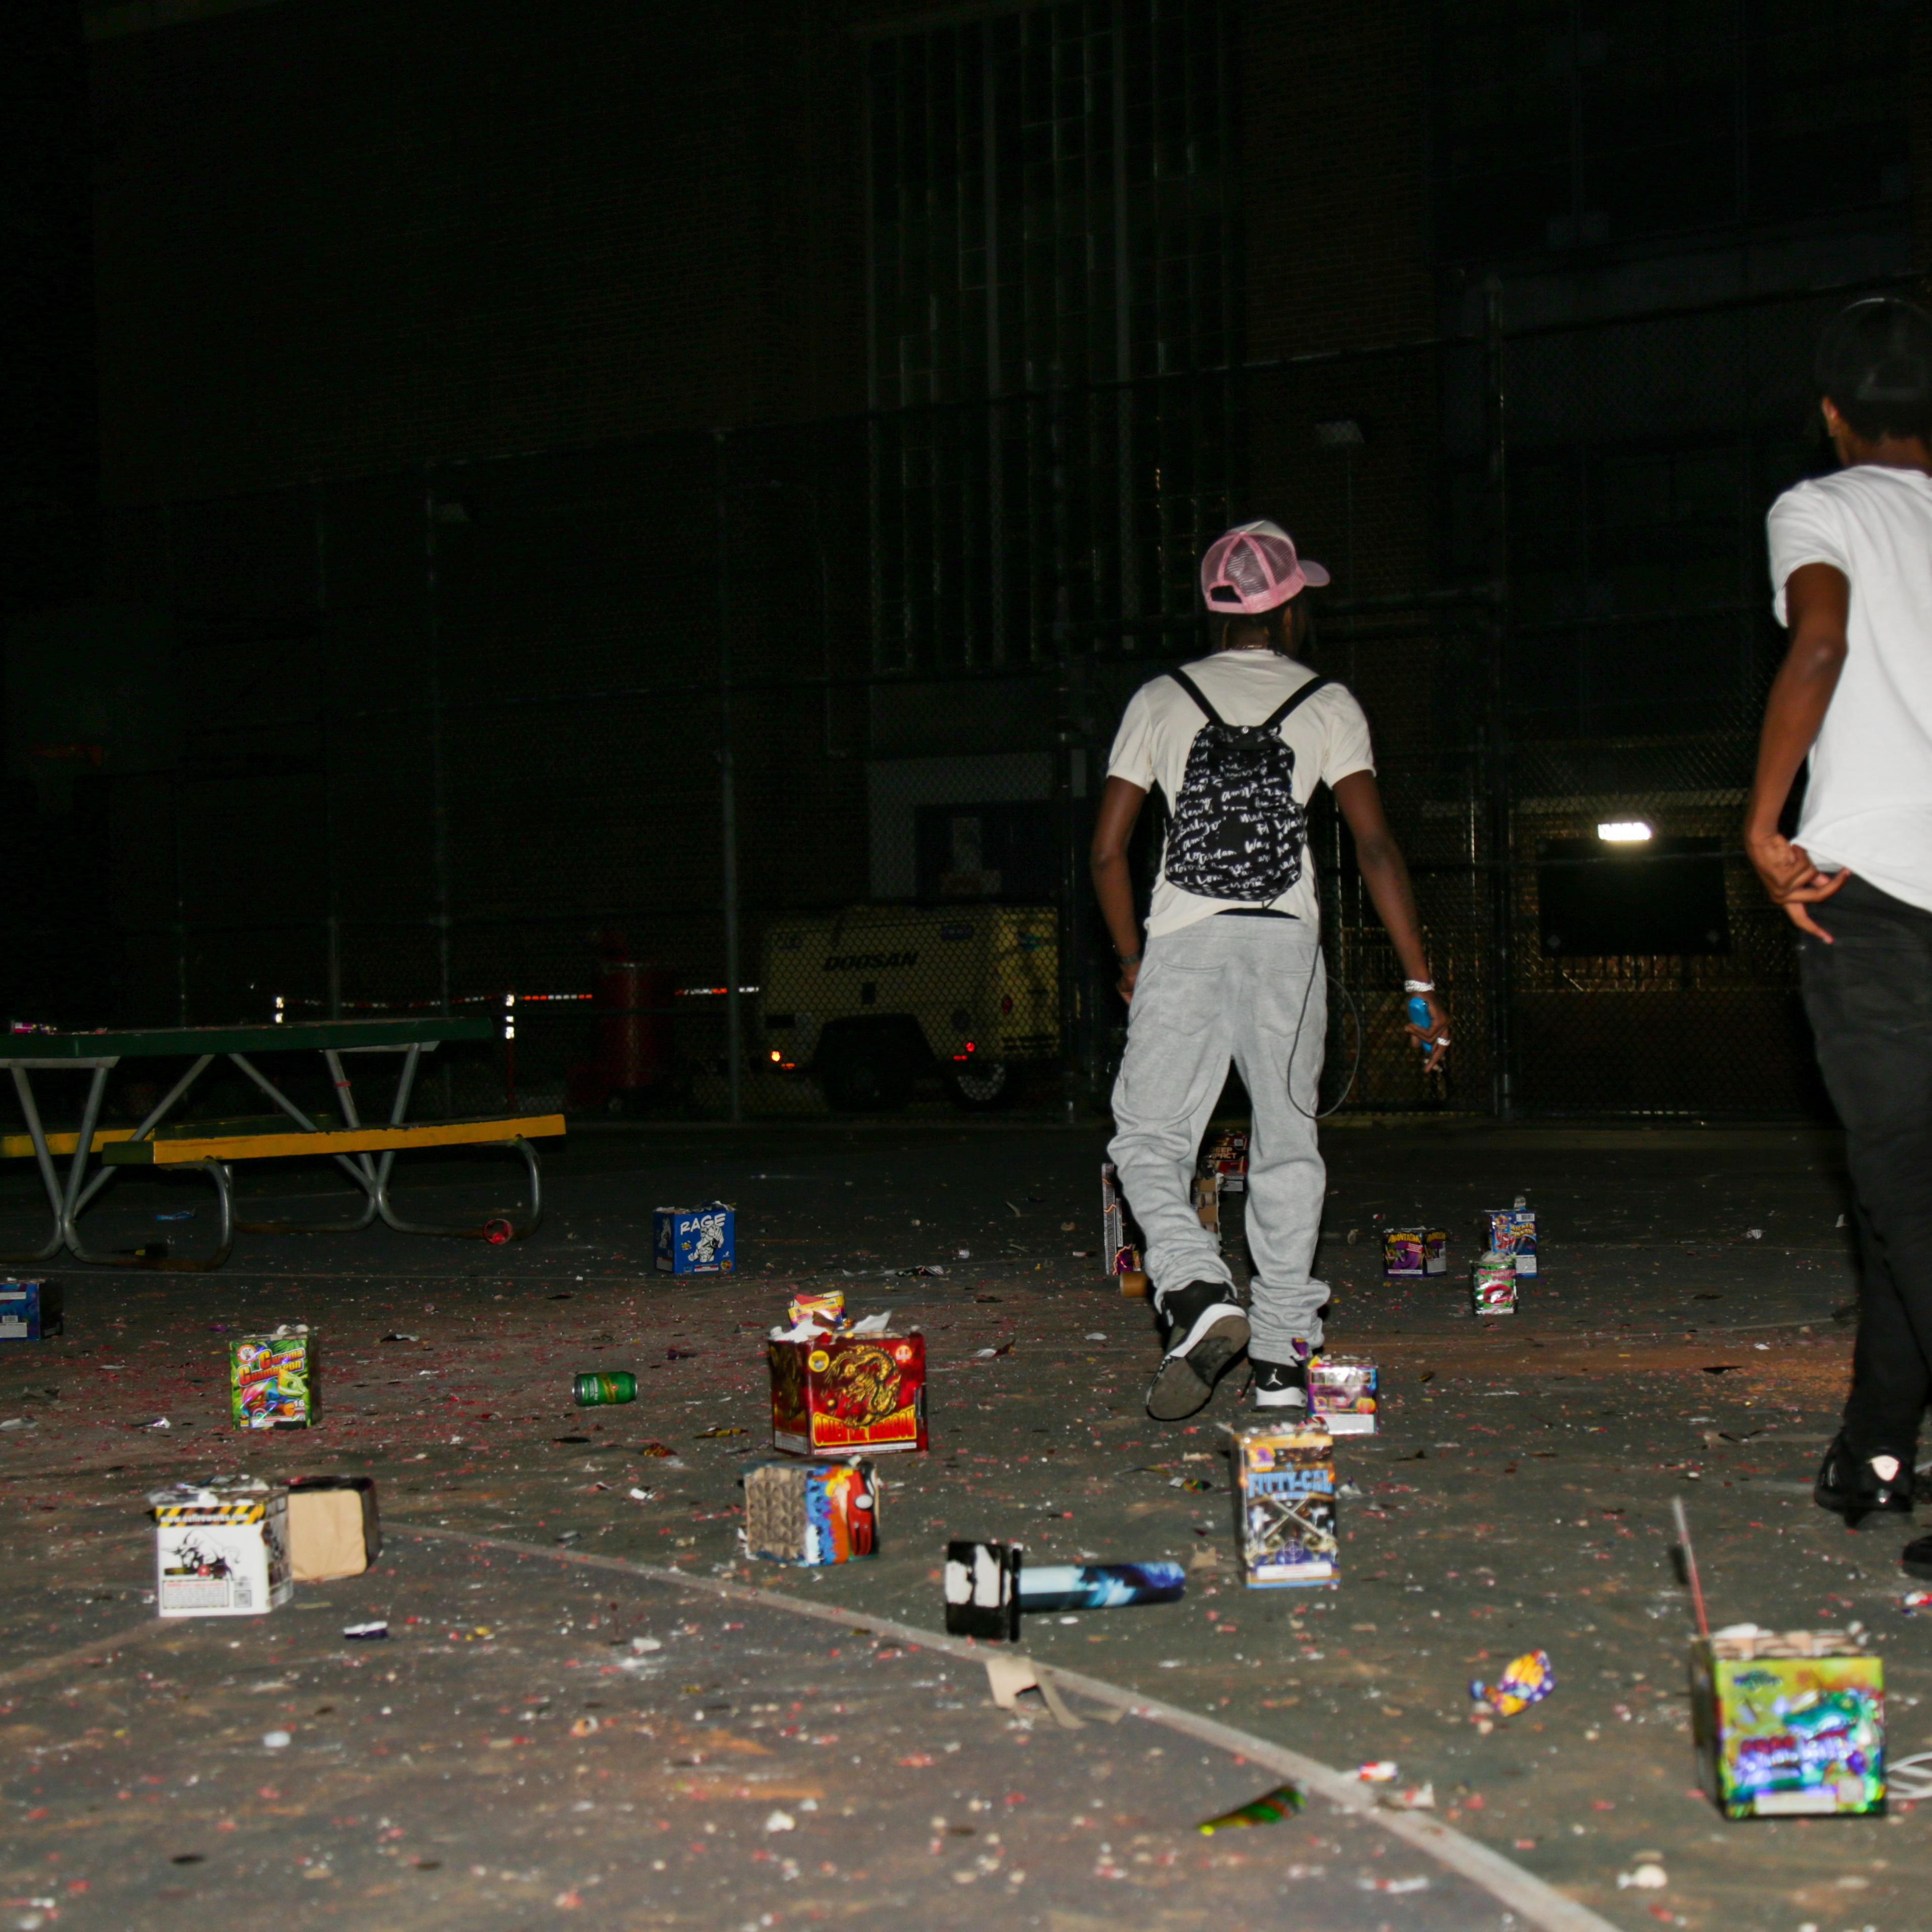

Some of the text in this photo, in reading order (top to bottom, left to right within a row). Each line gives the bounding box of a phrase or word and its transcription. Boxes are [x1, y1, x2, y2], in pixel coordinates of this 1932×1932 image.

[825, 952, 918, 970] DOOSAN
[680, 1213, 726, 1235] RAGE
[1248, 1469, 1333, 1499] FITTY-CAL
